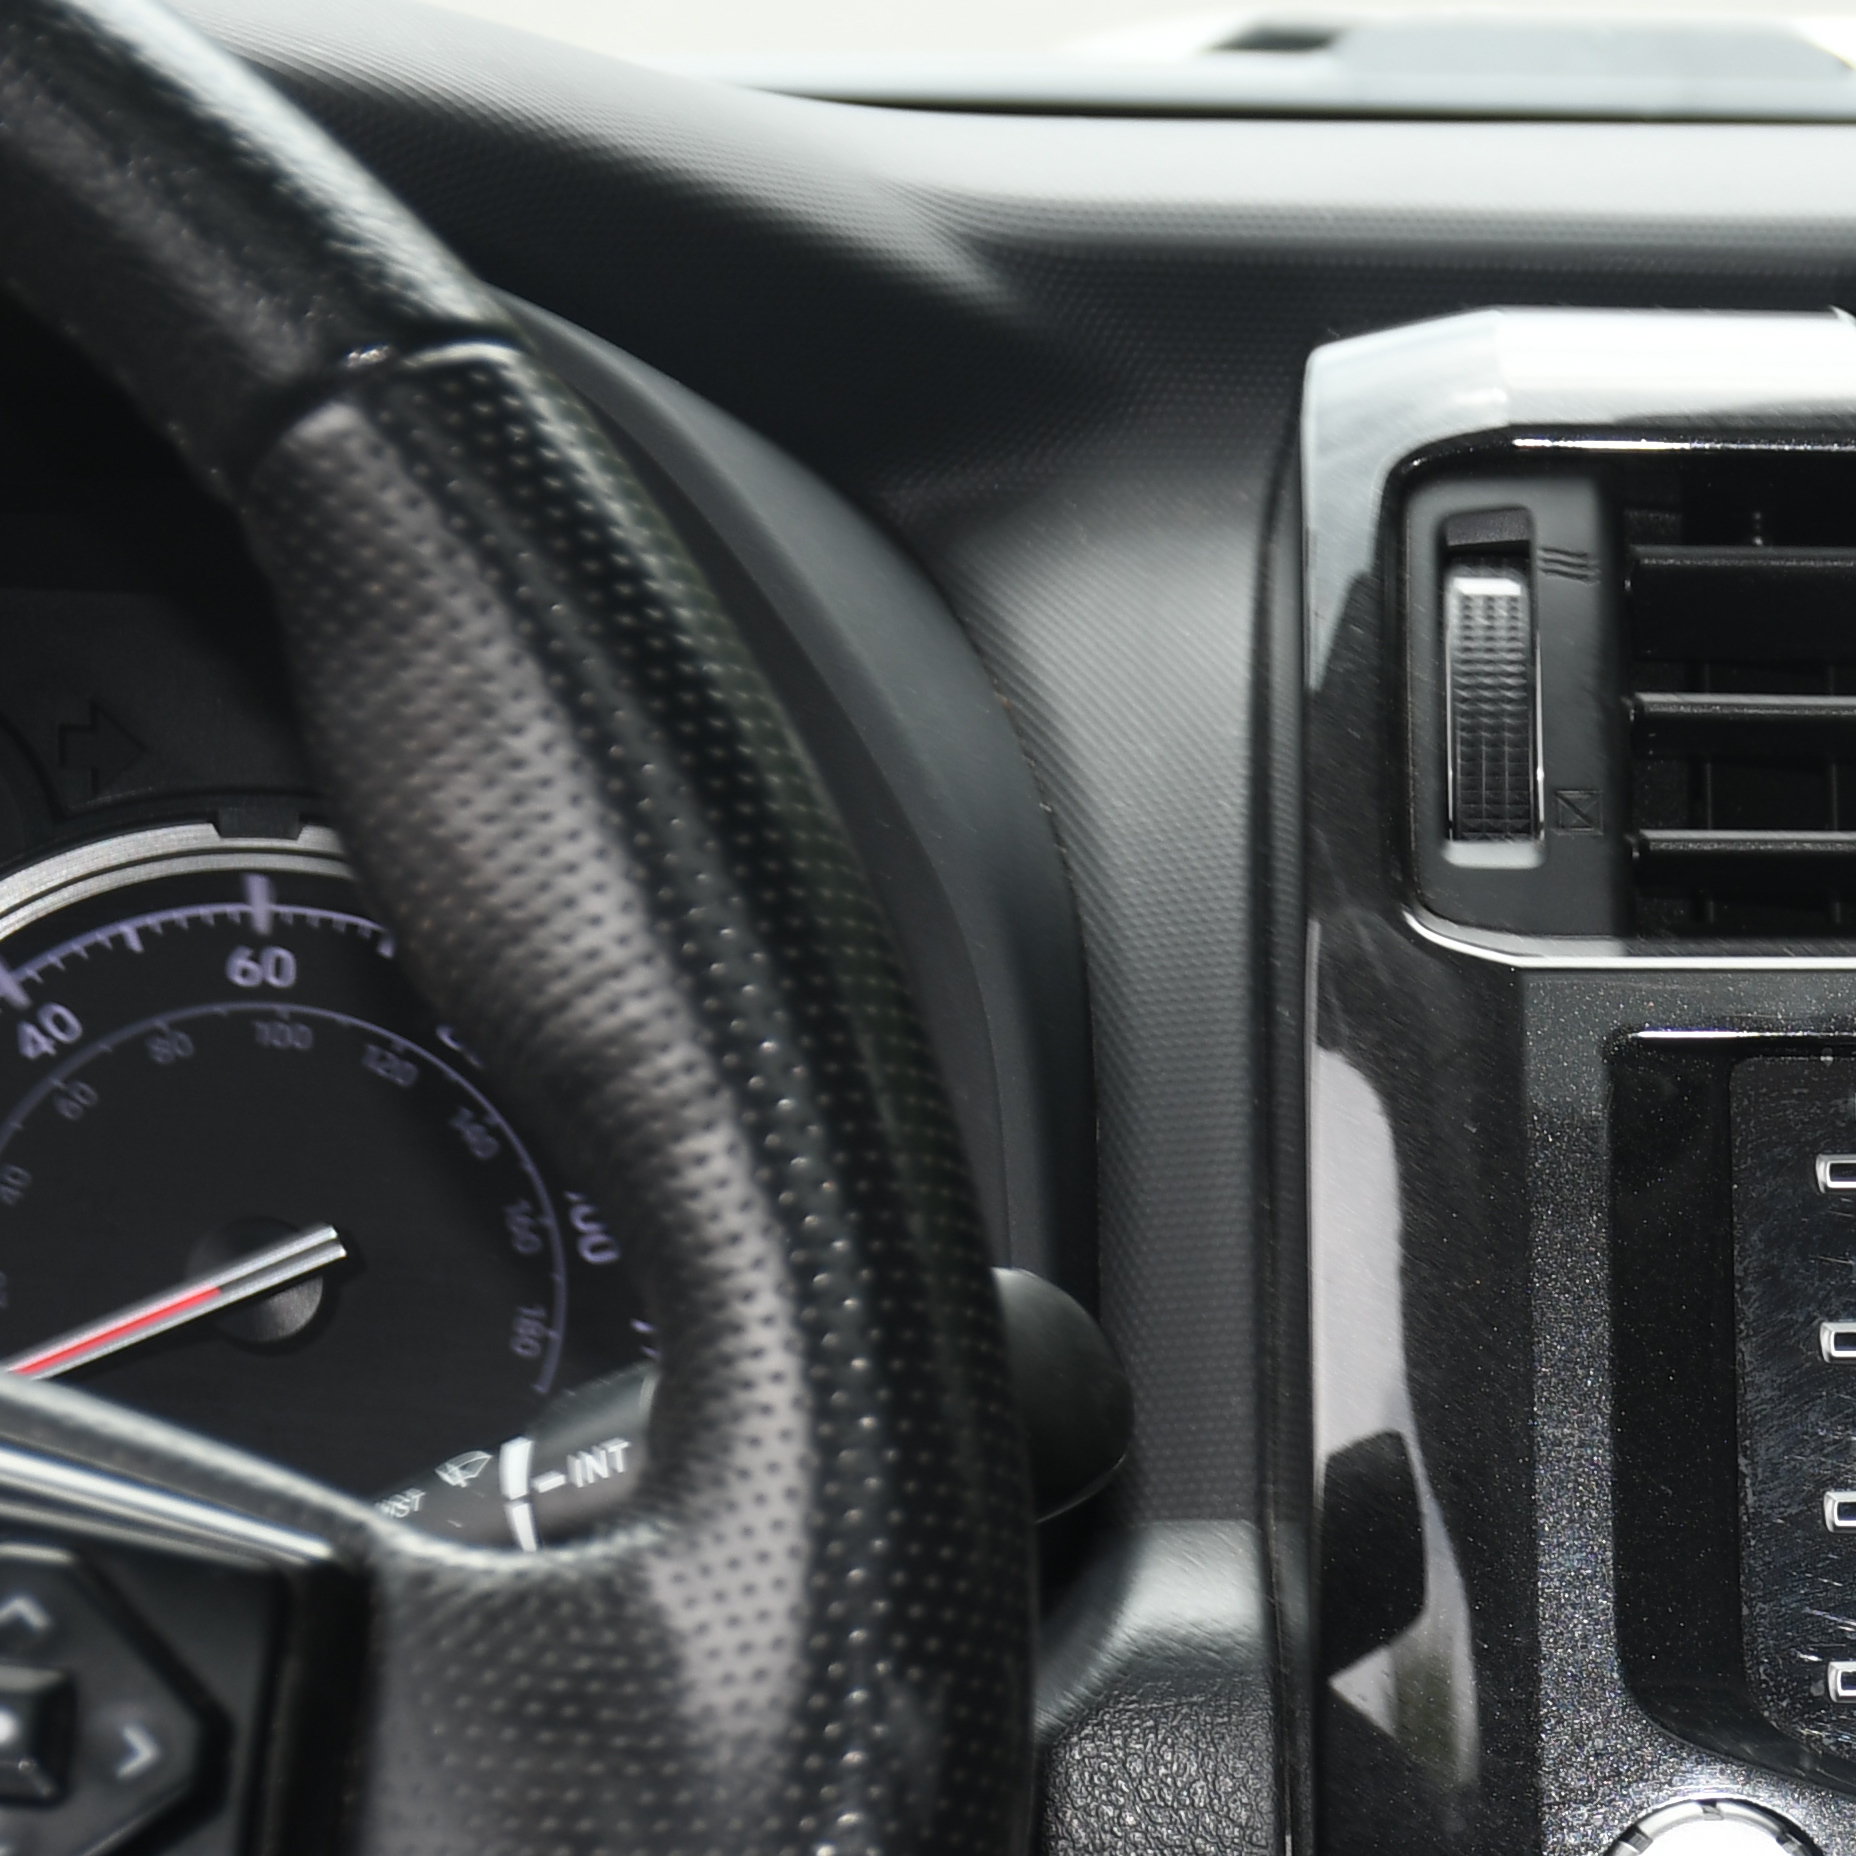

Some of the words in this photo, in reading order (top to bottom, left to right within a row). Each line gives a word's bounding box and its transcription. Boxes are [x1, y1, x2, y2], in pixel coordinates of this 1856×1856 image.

[226, 946, 296, 988] 60
[17, 1002, 83, 1060] 40
[145, 1029, 195, 1064] 80
[252, 1020, 314, 1050] 100
[361, 1044, 419, 1087] 120
[55, 1080, 98, 1120] 60
[510, 1304, 547, 1359] 180
